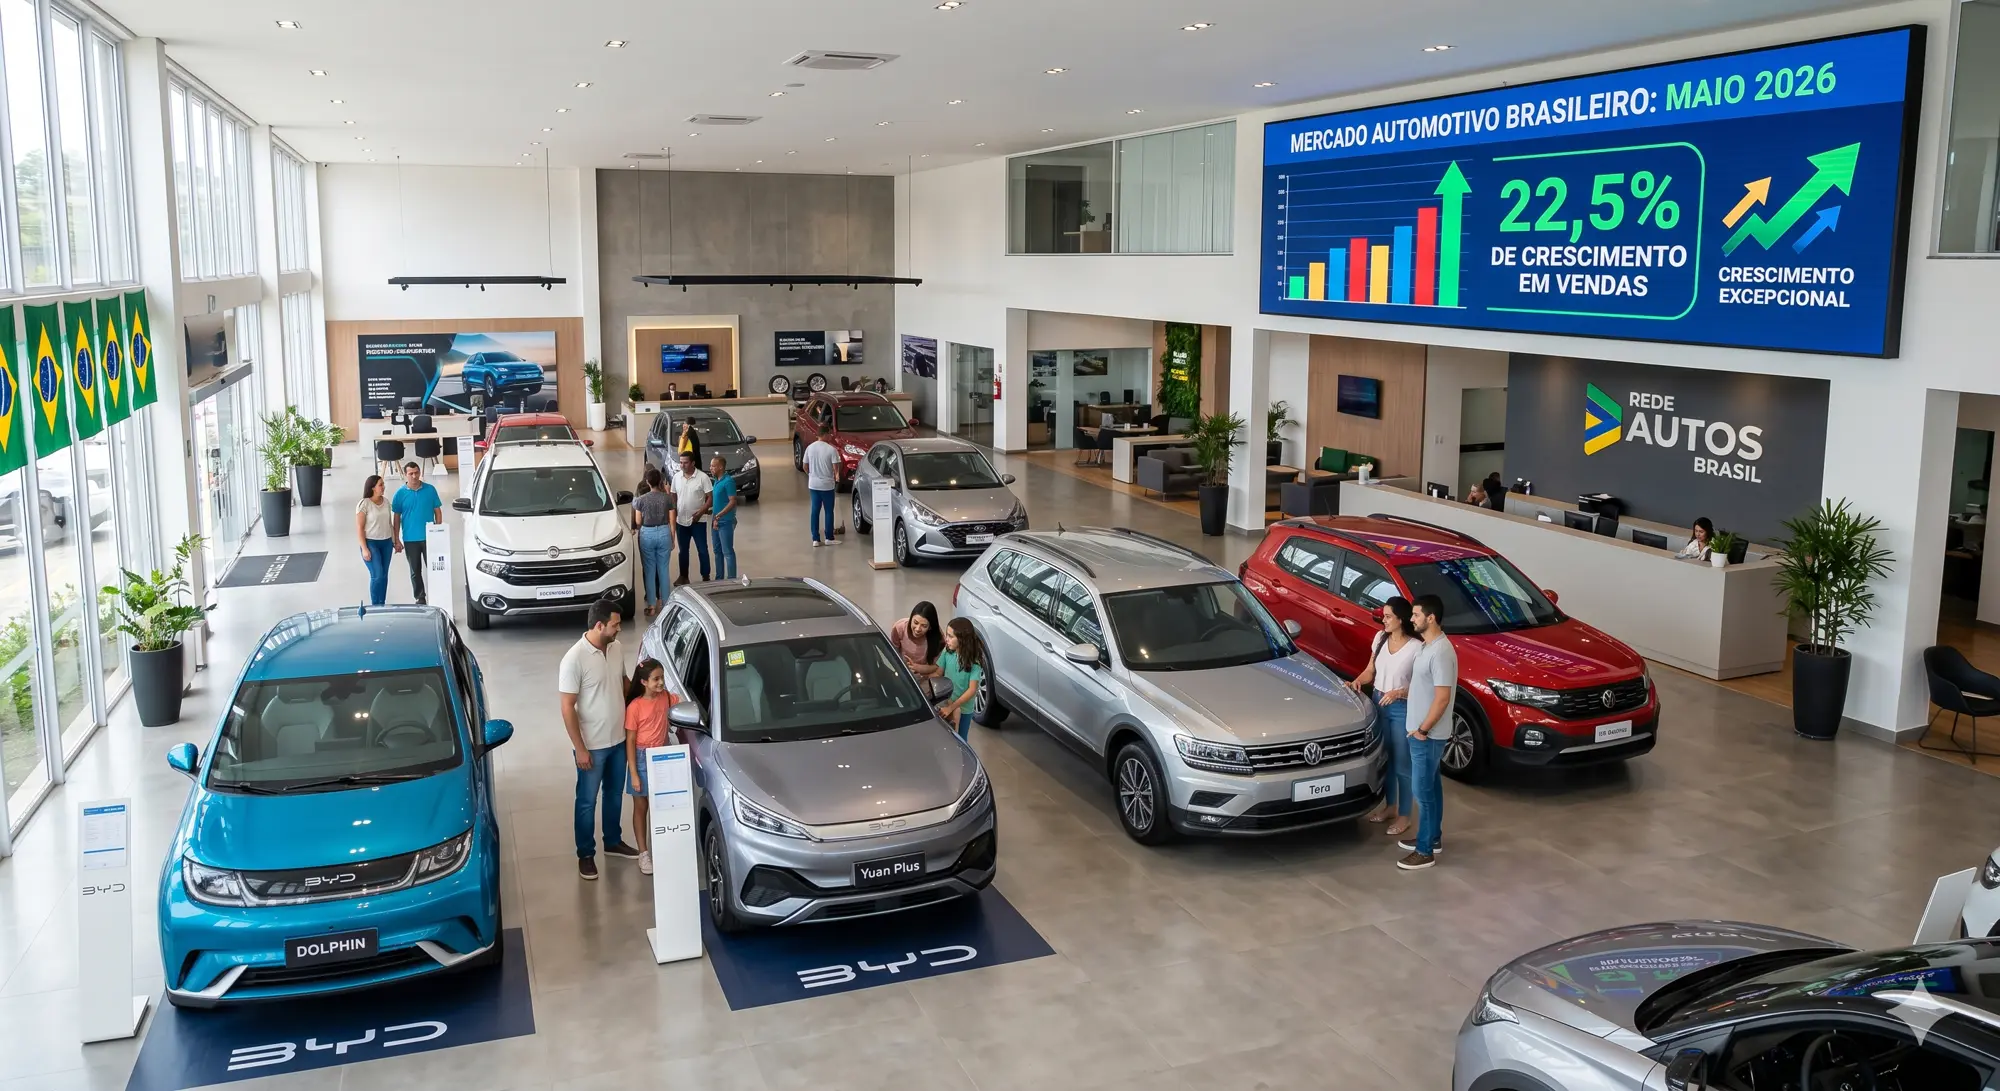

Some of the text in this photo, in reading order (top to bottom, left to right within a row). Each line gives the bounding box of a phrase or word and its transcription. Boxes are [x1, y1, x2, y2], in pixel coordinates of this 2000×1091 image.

[1290, 61, 1837, 153] MERCADO AUTOMOTIVO BRASILEIRO: MAIO 2026
[1499, 170, 1680, 244] 22,5%
[1491, 245, 1687, 268] DE CRESCIMENTO
[1518, 273, 1648, 297] EM VENDAS
[1718, 266, 1855, 284] CRESCIMENTO
[1719, 288, 1850, 308] EXCEPCIONAL
[1629, 391, 1675, 411] REDE
[1625, 411, 1763, 461] AUTOS
[1693, 456, 1762, 483] BRASIL
[1309, 784, 1331, 795] Tera
[655, 823, 691, 835] BYD
[868, 819, 907, 831] BYD
[304, 873, 356, 887] BYD
[860, 862, 920, 880] Yuan Plus
[82, 883, 126, 896] BYD
[296, 937, 366, 958] DOLPHIN
[796, 945, 978, 989] BYD
[227, 1020, 448, 1072] BYD
